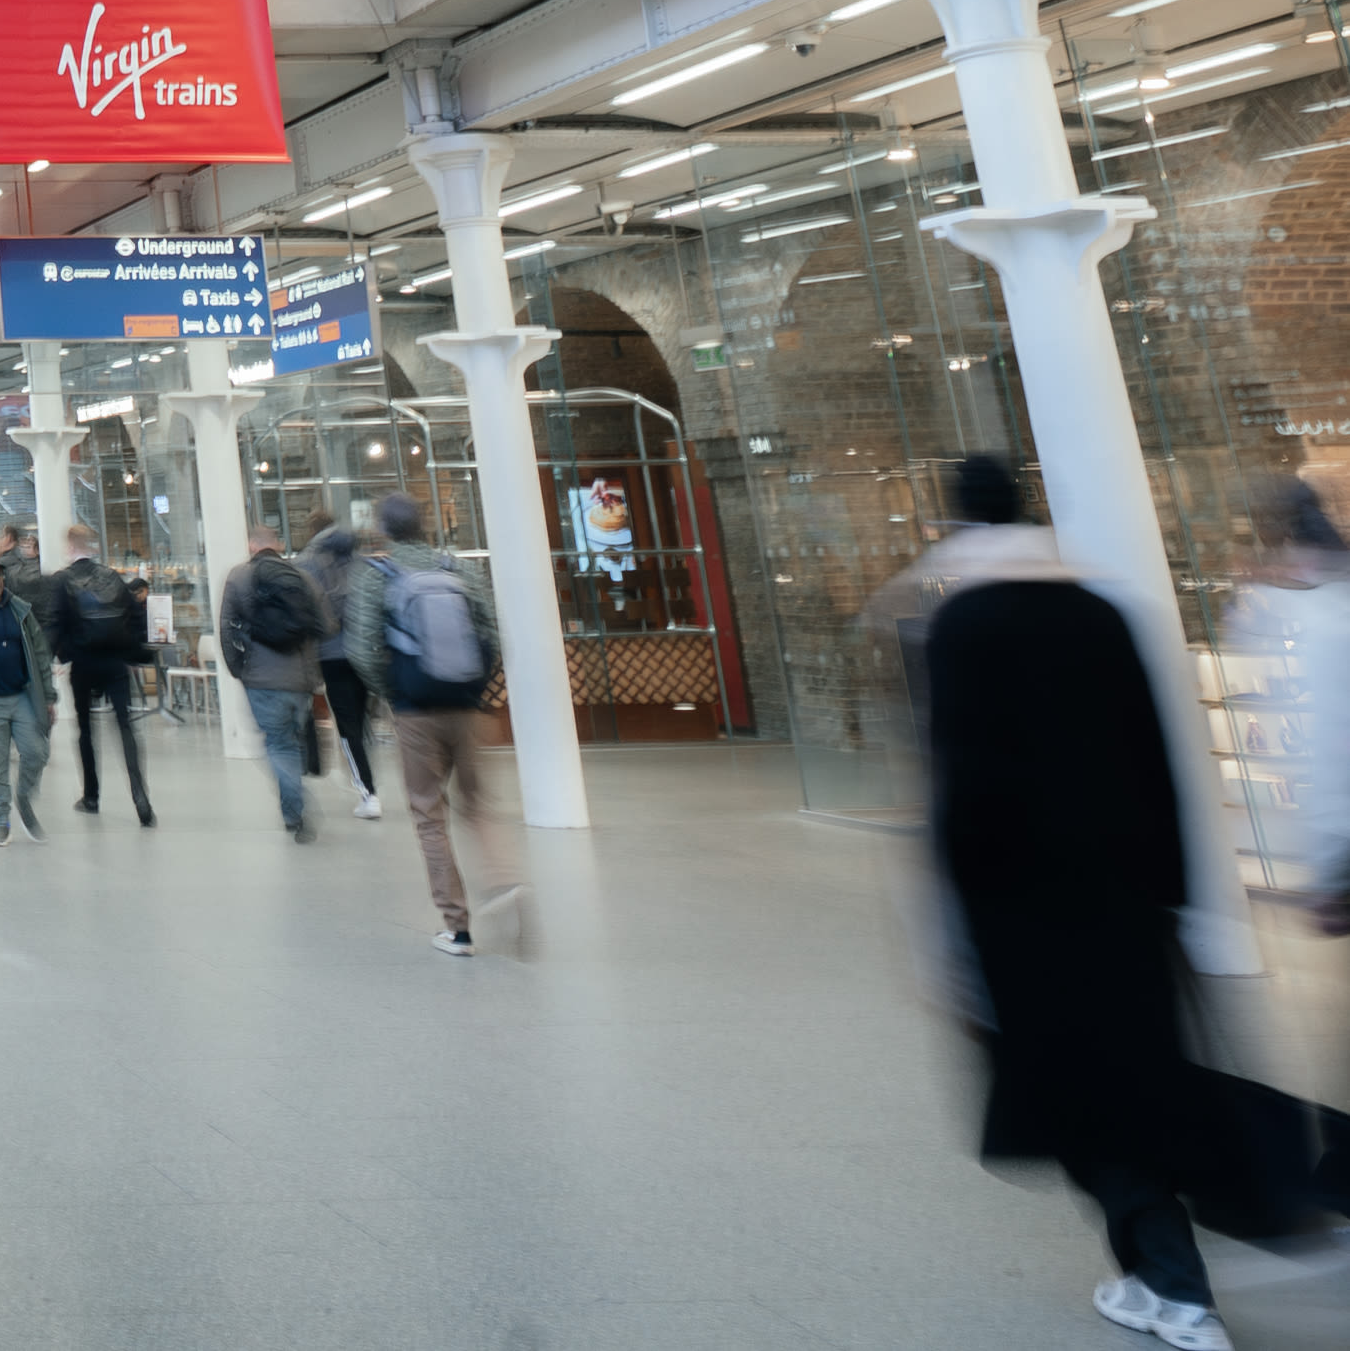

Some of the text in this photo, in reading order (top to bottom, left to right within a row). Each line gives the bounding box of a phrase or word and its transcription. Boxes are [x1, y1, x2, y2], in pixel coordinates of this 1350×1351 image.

[58, 3, 187, 120] Virgin
[154, 77, 238, 106] trains
[137, 238, 234, 258] Underground
[115, 262, 177, 281] Arrivées
[179, 263, 237, 281] Arrivals
[200, 289, 240, 306] Taxis
